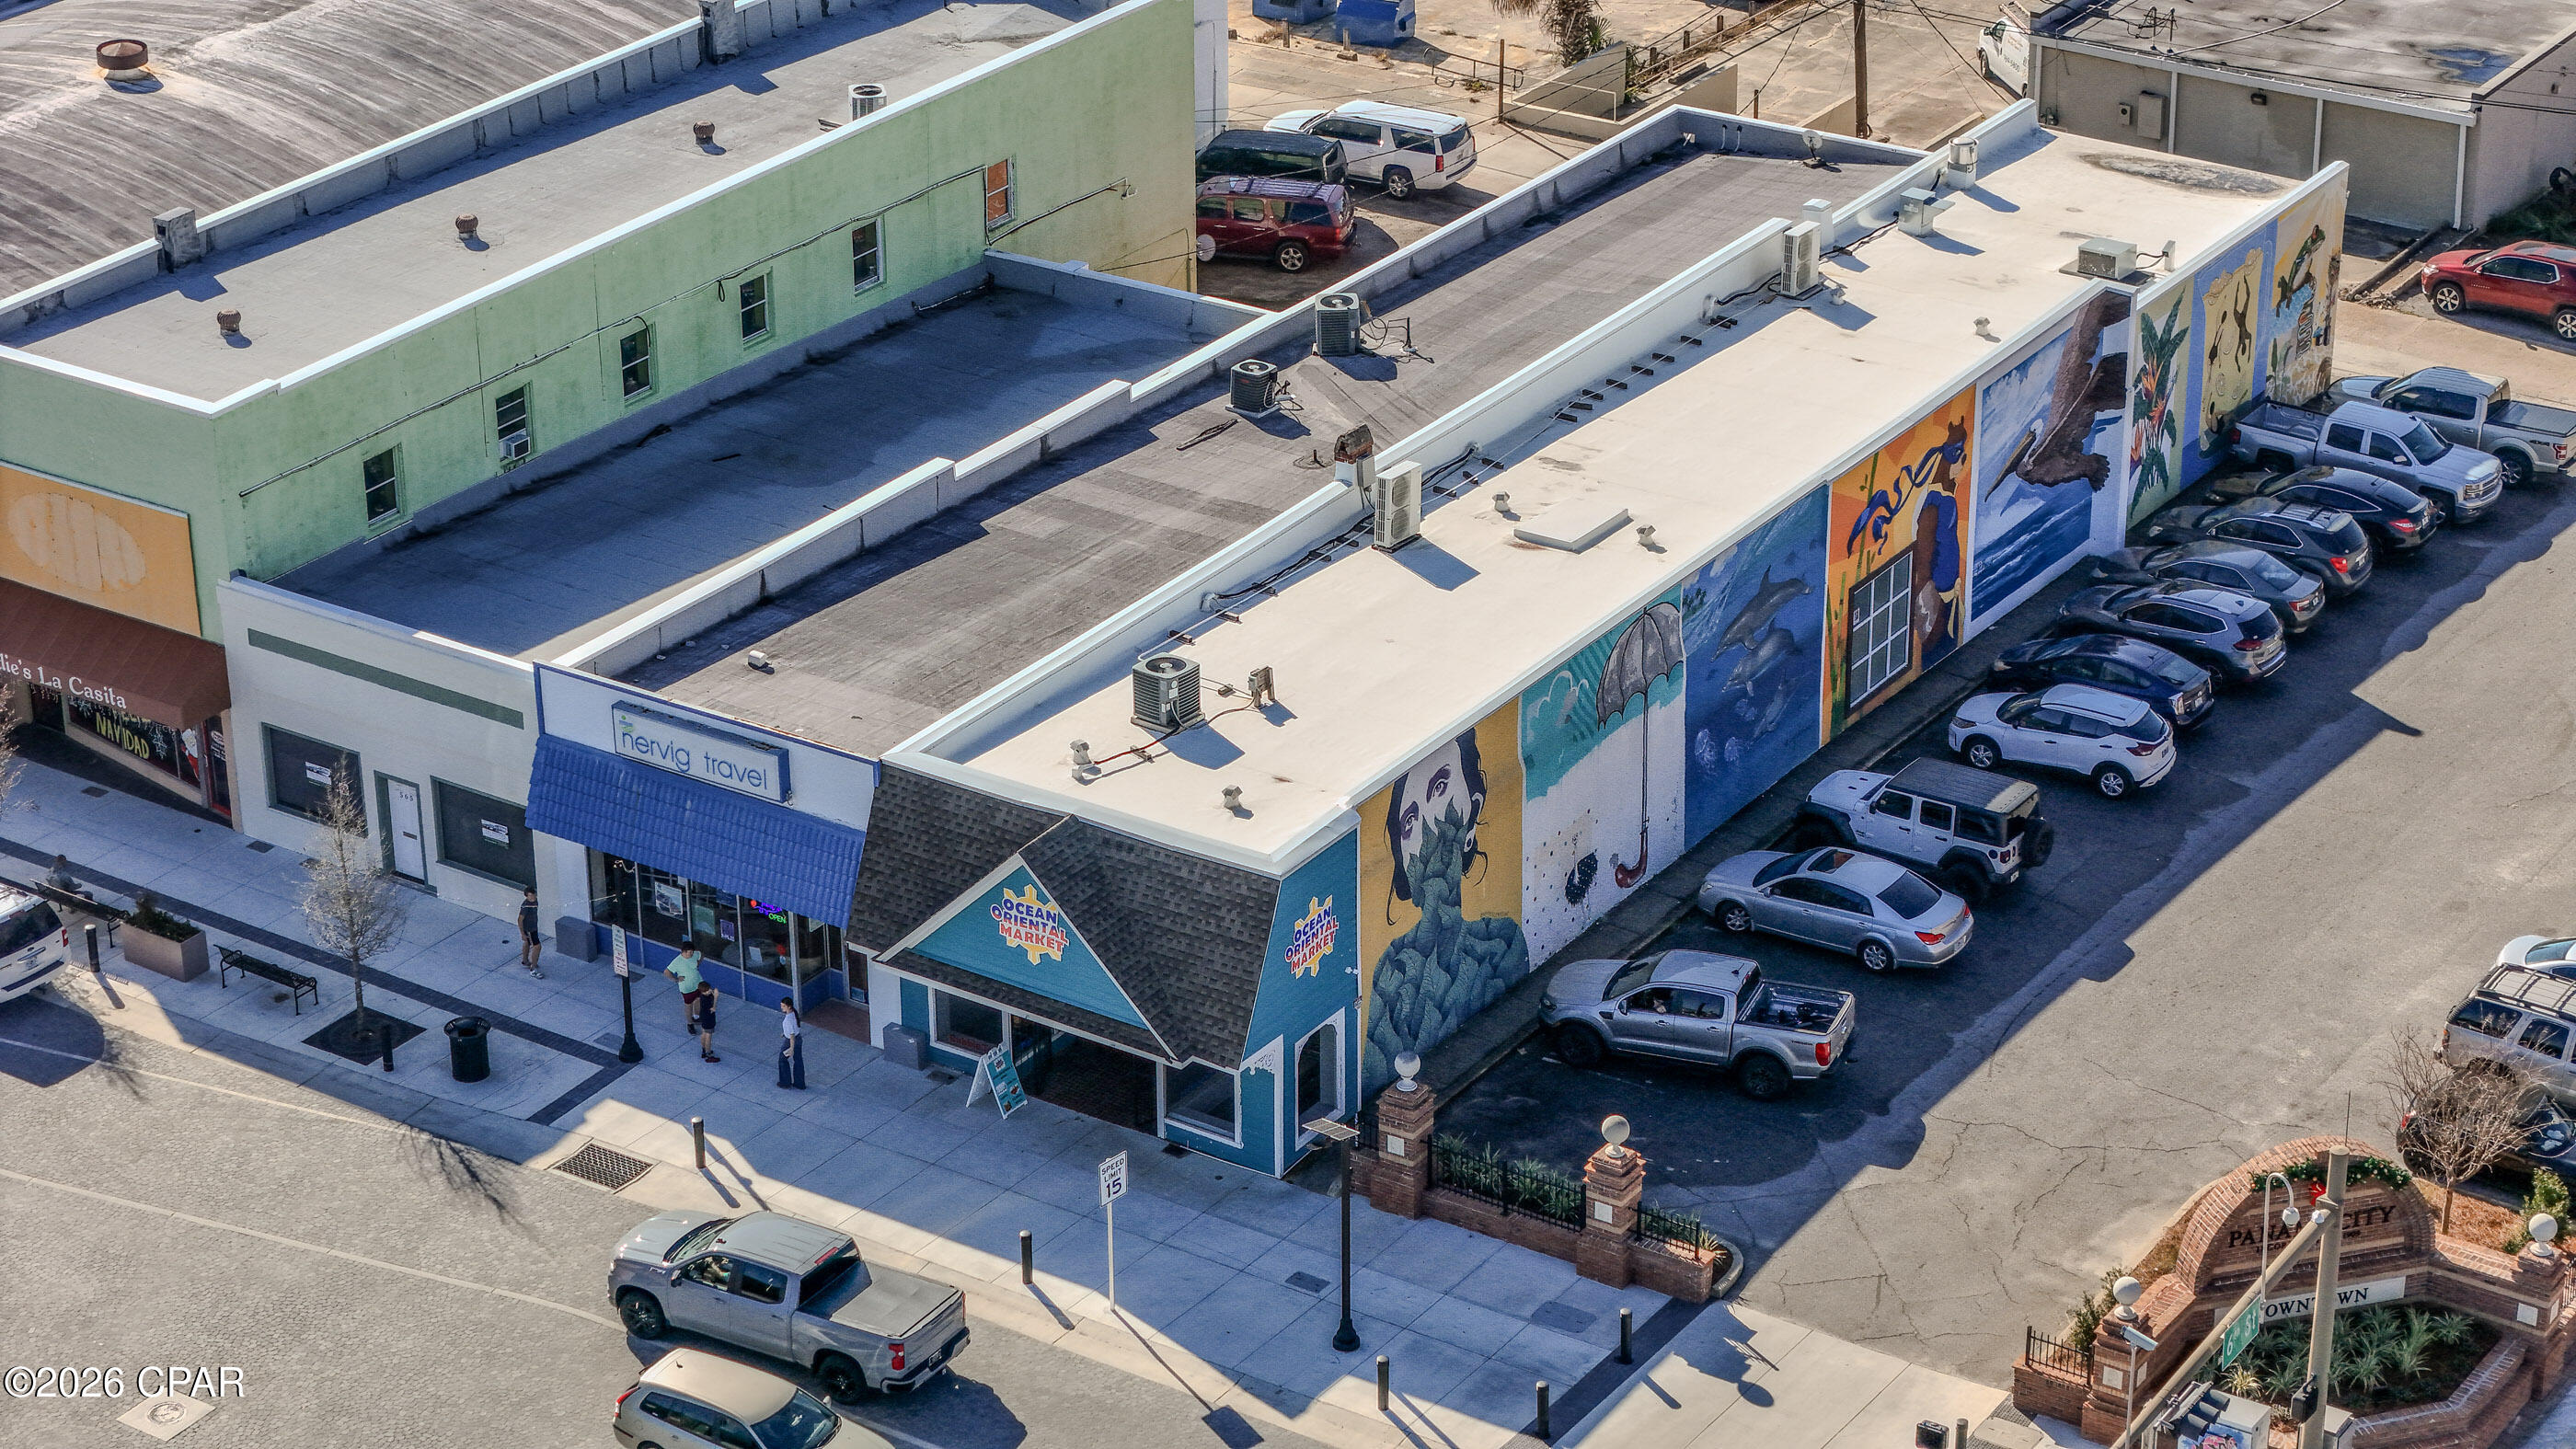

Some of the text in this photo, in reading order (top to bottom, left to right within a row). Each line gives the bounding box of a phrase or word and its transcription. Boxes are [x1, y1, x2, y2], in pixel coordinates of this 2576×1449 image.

[38, 666, 63, 690] La
[68, 676, 127, 709] Casita
[96, 711, 150, 759] NAVIDAD
[622, 731, 767, 790] nervig travel
[768, 913, 787, 925] OPEN
[991, 904, 1068, 944] ORIENTAL
[1003, 898, 1057, 925] OCEAN
[1294, 905, 1331, 943] OCEAN
[1000, 923, 1064, 952] MARKET
[1285, 916, 1339, 960] ORIENTAL
[1292, 930, 1336, 973] MARKET
[1101, 1157, 1124, 1176] SPEED
[1104, 1167, 1121, 1183] LIMIT
[1106, 1177, 1121, 1198] 15
[2245, 1309, 2257, 1336] St
